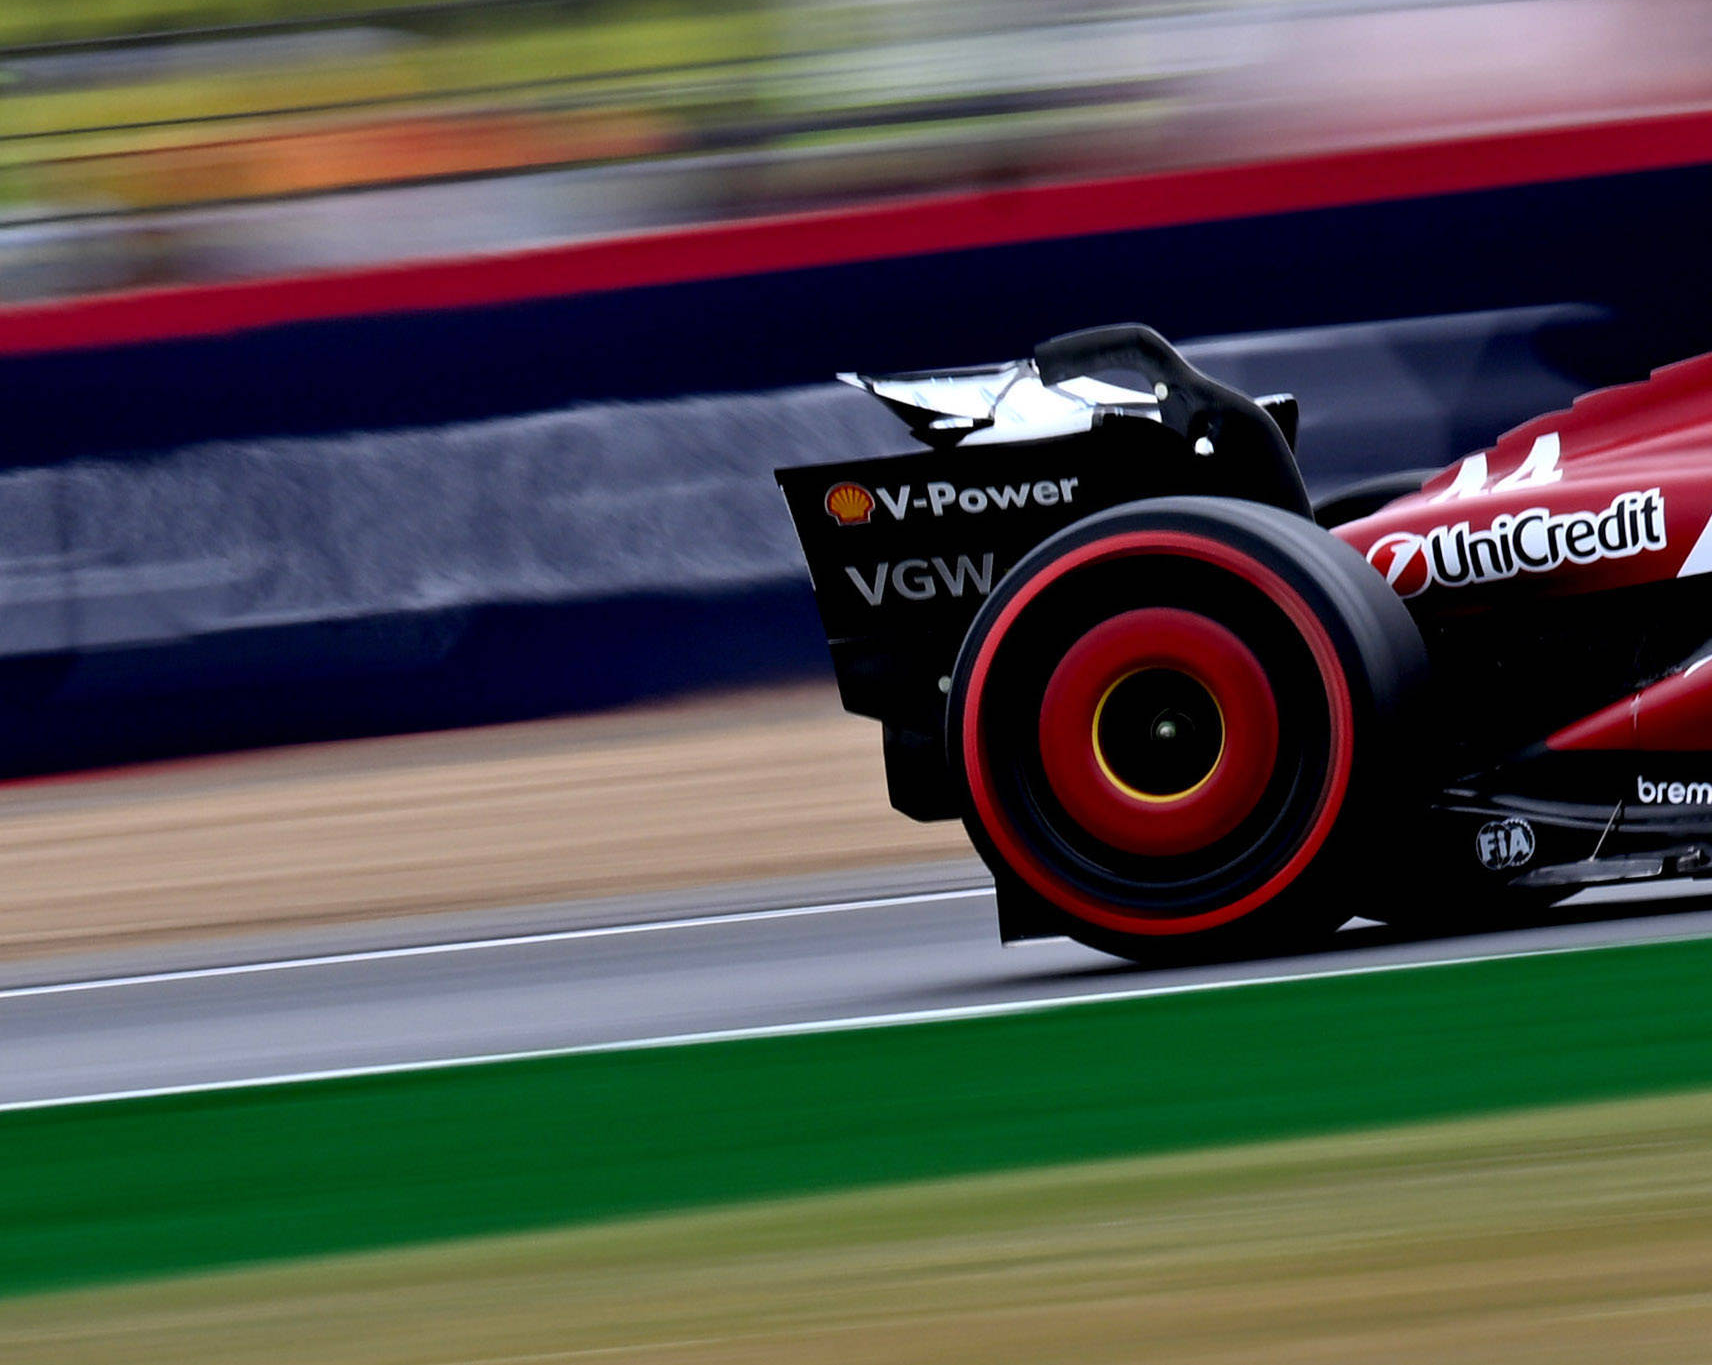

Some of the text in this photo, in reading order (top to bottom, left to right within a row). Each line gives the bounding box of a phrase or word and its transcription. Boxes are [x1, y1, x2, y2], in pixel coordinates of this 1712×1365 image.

[876, 477, 1079, 521] V-Power
[1431, 491, 1662, 584] UniCredit
[845, 552, 995, 606] VGW
[1479, 826, 1531, 863] FIA
